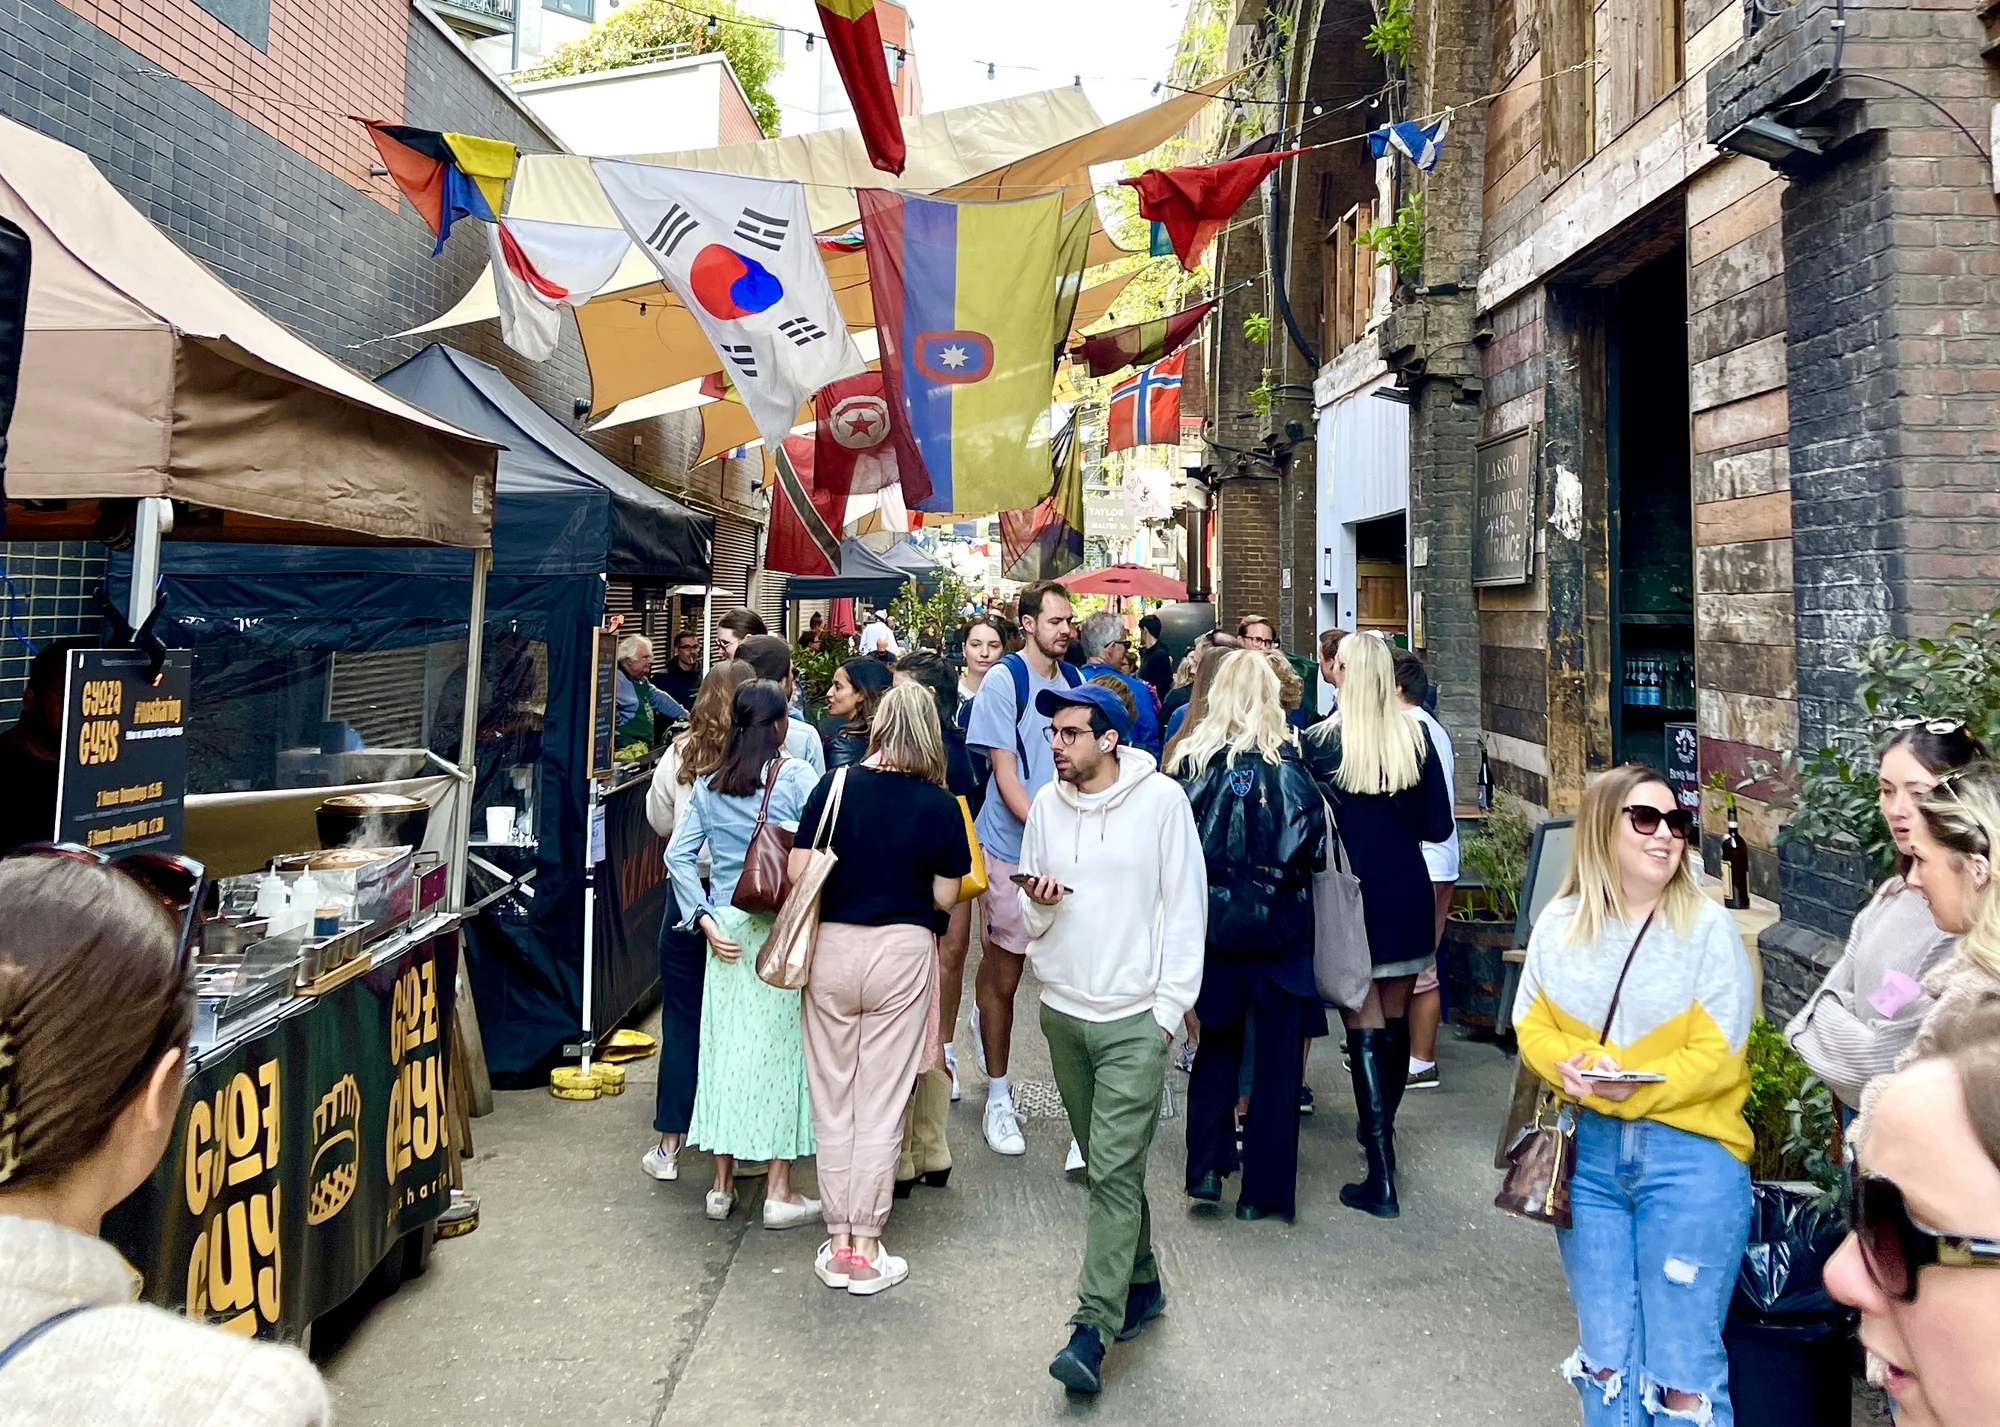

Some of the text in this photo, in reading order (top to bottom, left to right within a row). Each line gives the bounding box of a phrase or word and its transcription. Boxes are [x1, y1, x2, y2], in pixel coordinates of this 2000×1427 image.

[1485, 453, 1519, 483] LASSCO
[1089, 507, 1124, 517] TAYLOR
[1480, 487, 1523, 518] FLOORING
[1091, 522, 1118, 530] MALTBY
